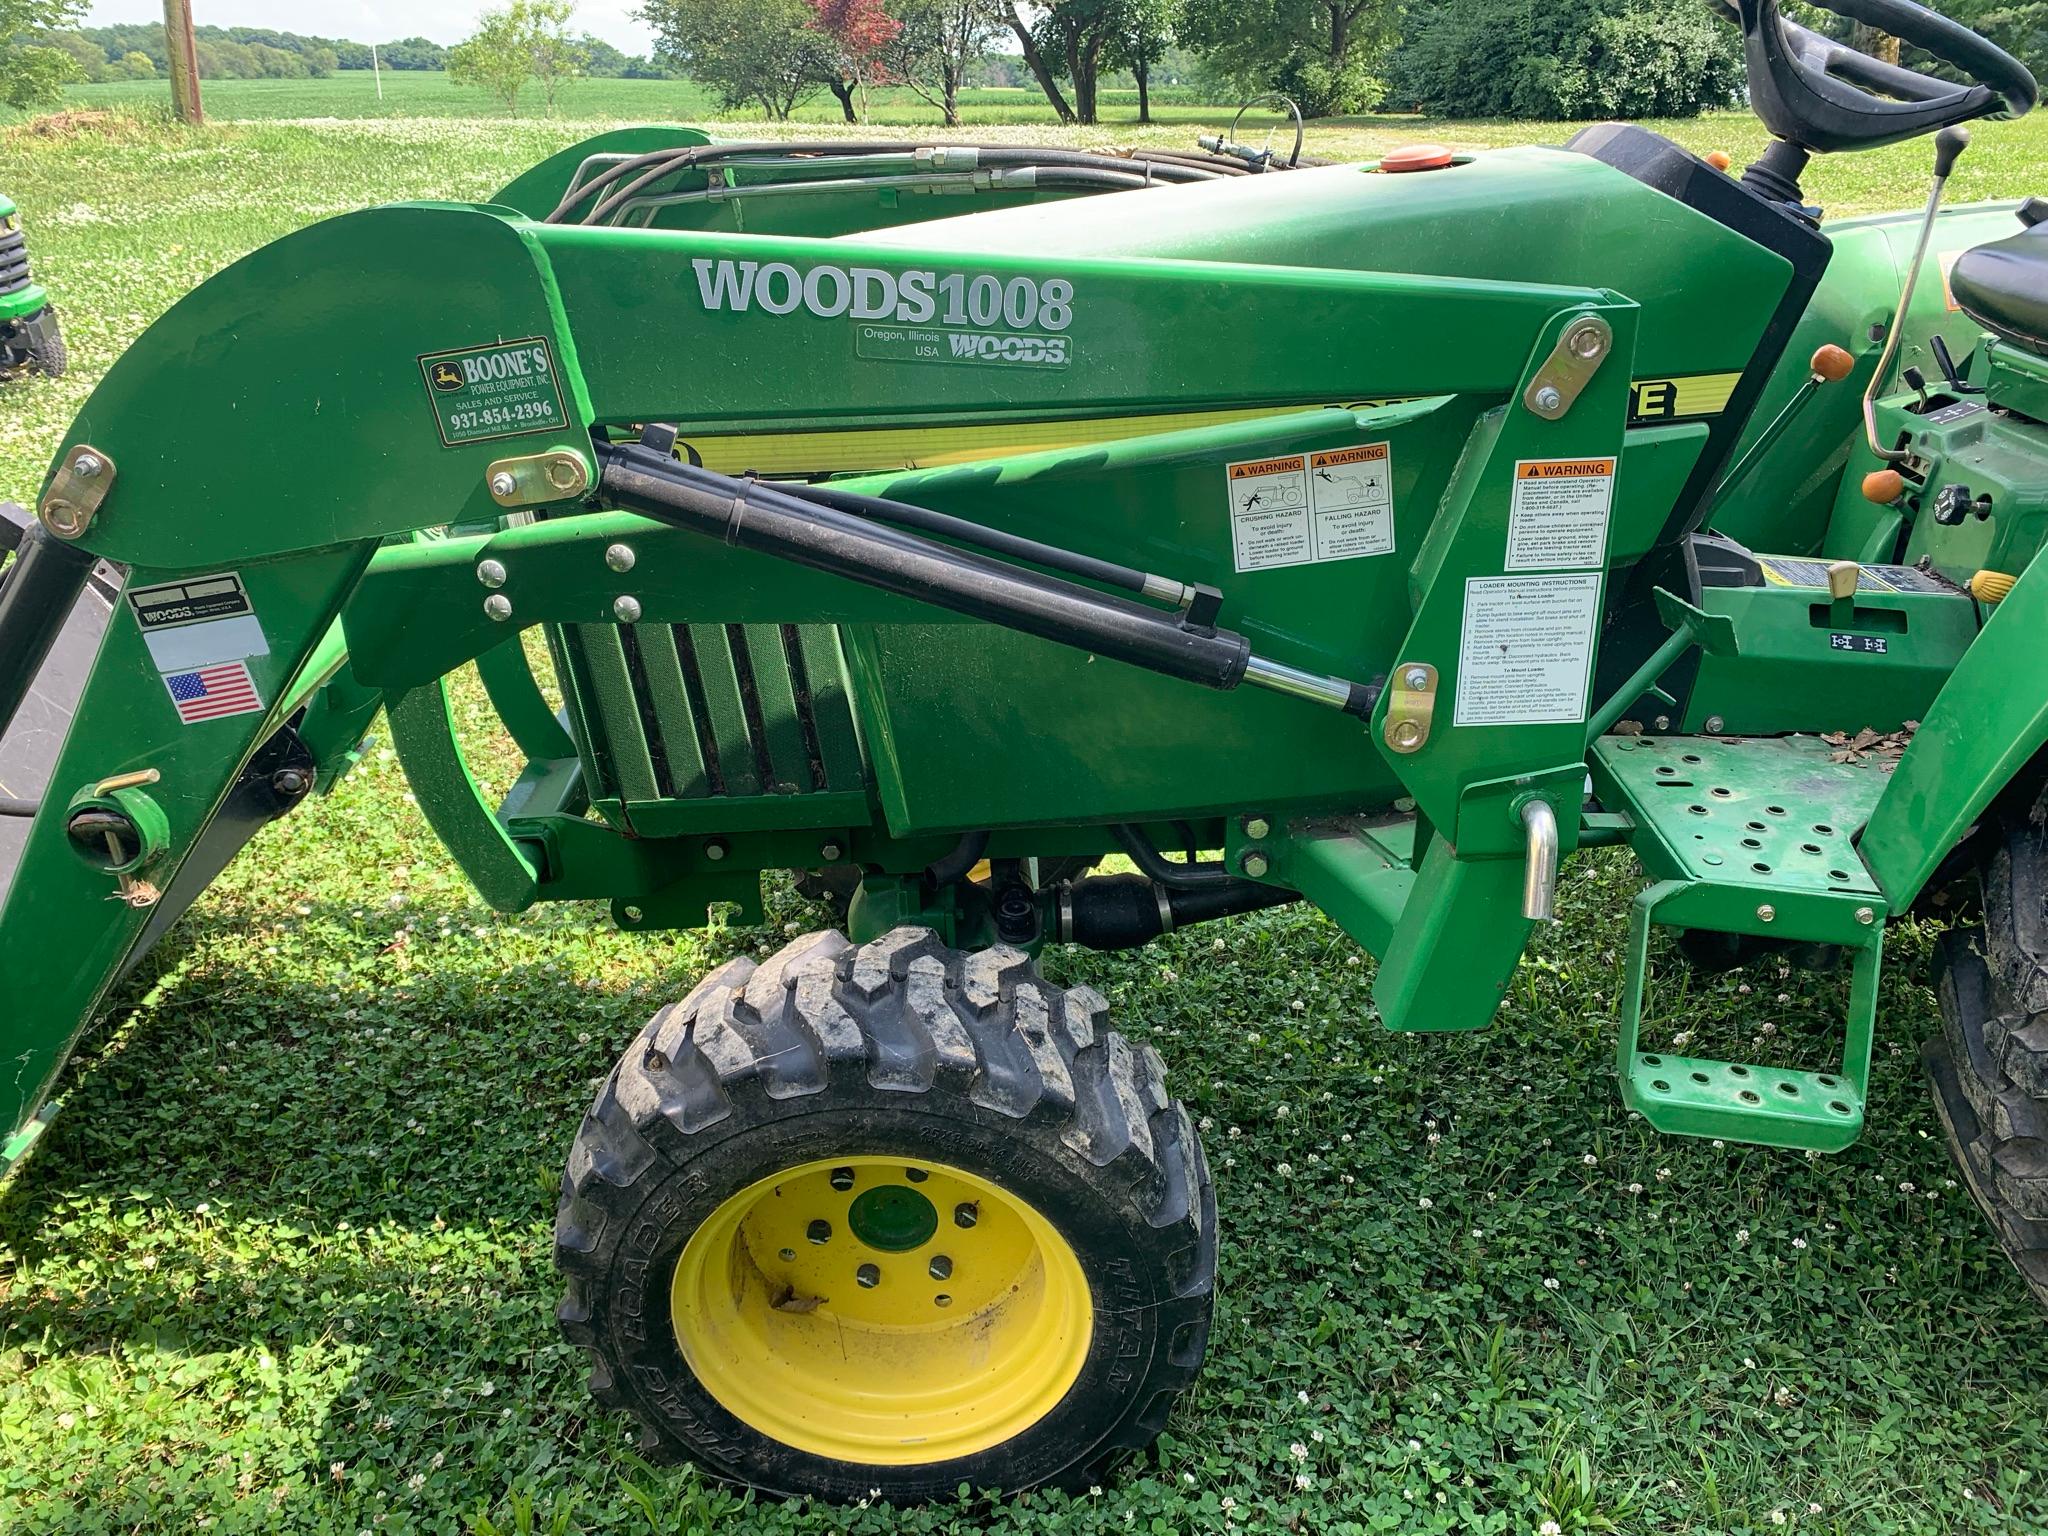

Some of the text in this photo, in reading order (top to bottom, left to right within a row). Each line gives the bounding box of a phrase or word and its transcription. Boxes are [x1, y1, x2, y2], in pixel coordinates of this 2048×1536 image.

[864, 328, 940, 343] Oregon, Illinois
[915, 345, 940, 358] USA
[948, 333, 1066, 364] WOODS
[462, 347, 548, 383] BOONE'S
[470, 382, 495, 395] POWER
[495, 375, 537, 392] EQUIPMENT,
[535, 373, 550, 385] INC.
[455, 390, 538, 410] SALES AND SERVICE
[451, 400, 552, 430] 937-854-2396
[1330, 449, 1383, 463] WARNING
[1248, 460, 1300, 474] WARNING
[1543, 463, 1605, 475] WARNING
[1240, 510, 1301, 522] CRUSHING HAZARD
[1324, 509, 1380, 521] FALLING HAZARD
[1357, 519, 1374, 527] injury
[143, 607, 193, 623] WOODS
